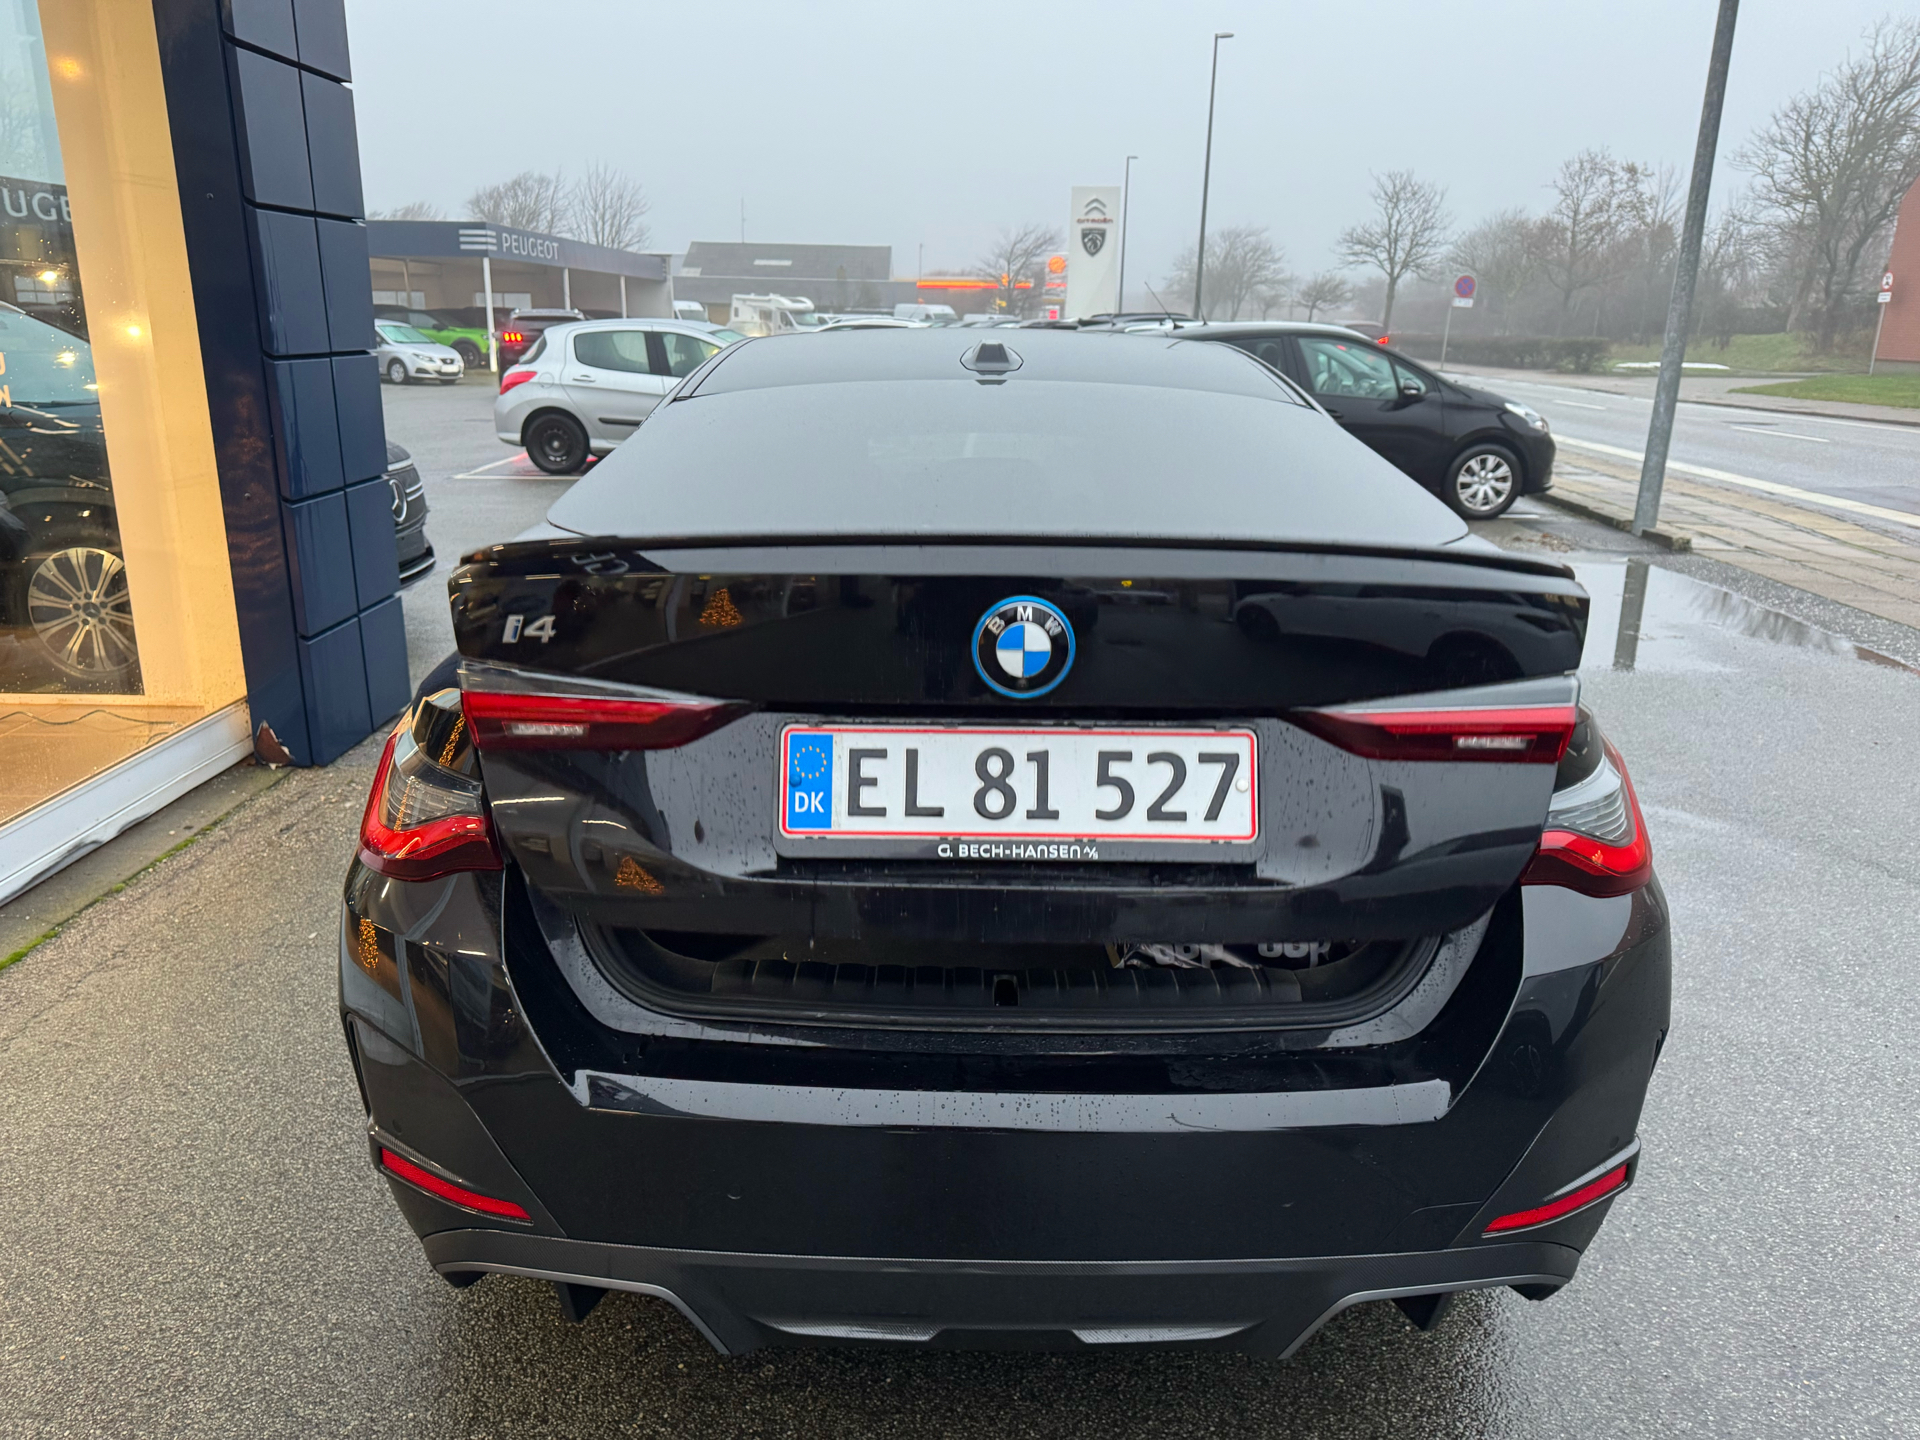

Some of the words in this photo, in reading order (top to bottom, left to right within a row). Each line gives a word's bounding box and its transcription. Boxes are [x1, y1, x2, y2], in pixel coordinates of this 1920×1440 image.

[502, 232, 559, 260] PEUGEOT
[502, 614, 557, 643] i4
[988, 606, 1062, 637] BMW
[847, 748, 944, 817] EL
[973, 747, 1060, 821] 81
[1095, 749, 1241, 822] 527
[794, 791, 825, 814] DK
[958, 843, 1081, 860] BECH-HANSEN
